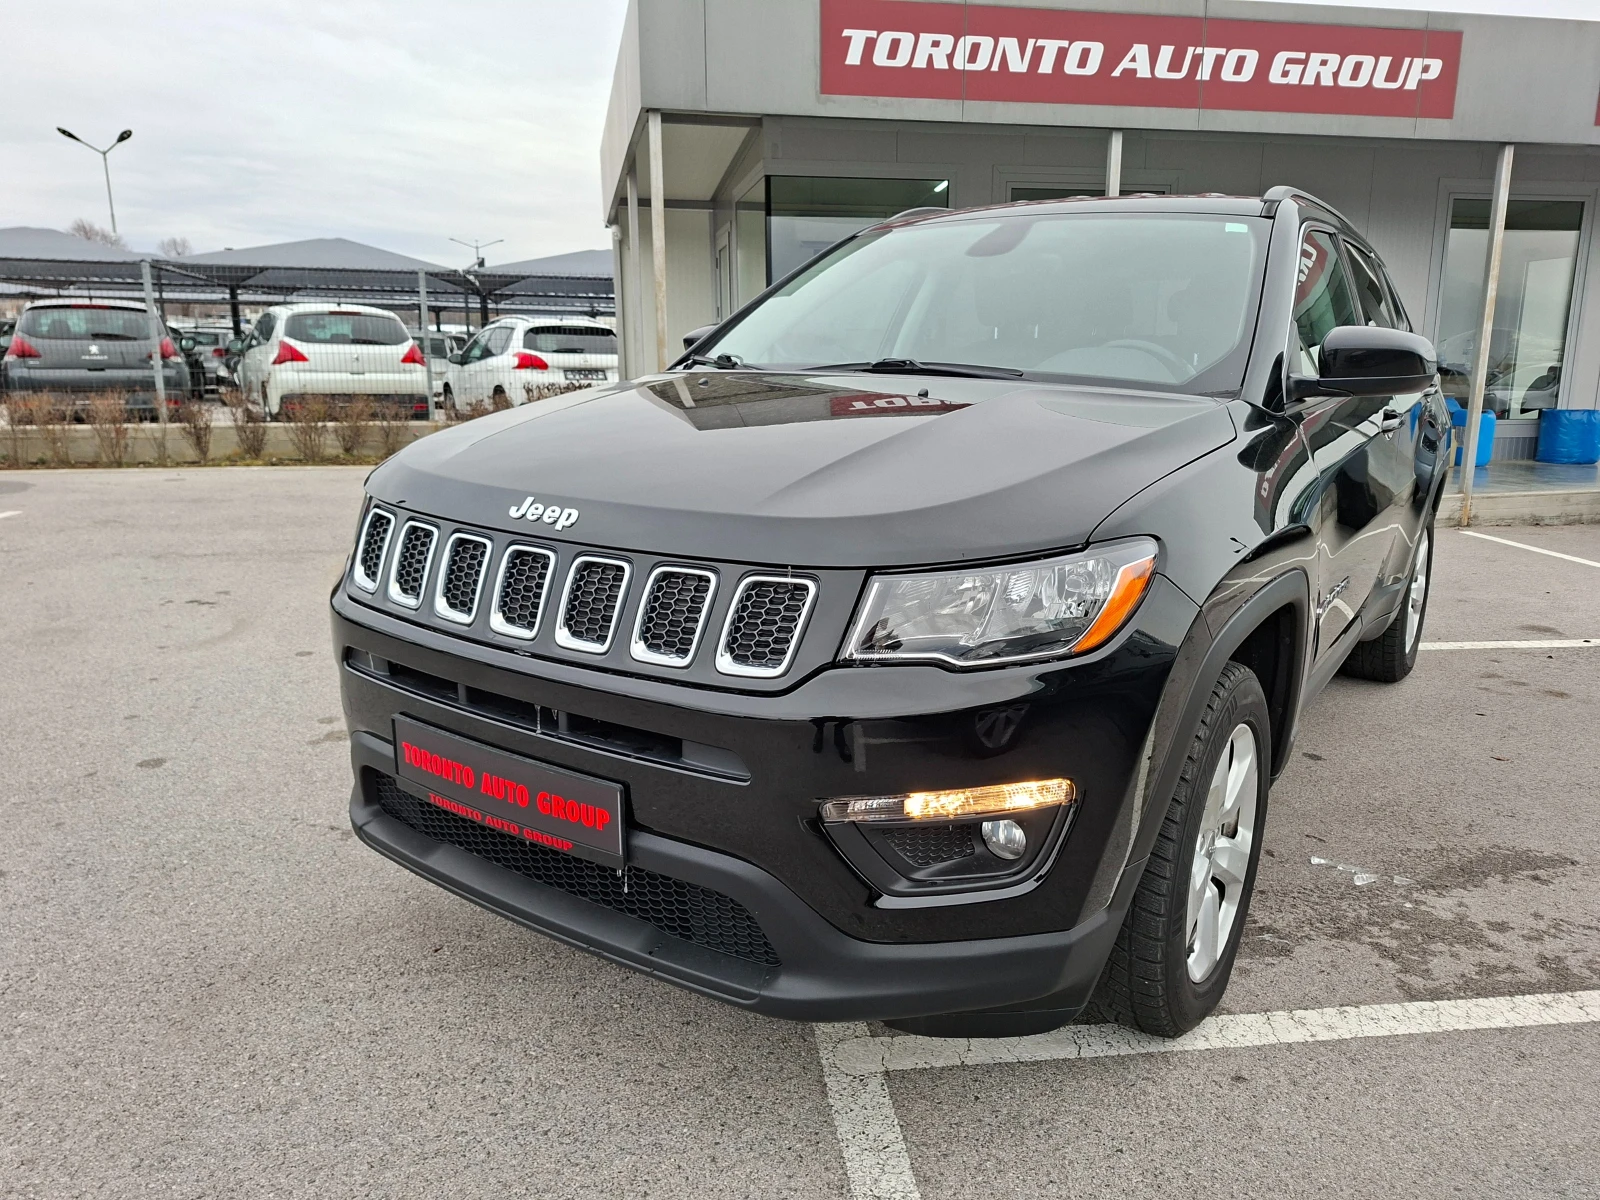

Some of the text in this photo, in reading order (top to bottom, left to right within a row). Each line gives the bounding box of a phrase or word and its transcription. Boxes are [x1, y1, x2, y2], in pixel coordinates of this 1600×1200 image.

[841, 28, 1443, 90] TORONTO AUTO GROUP
[509, 496, 579, 532] Jeep
[402, 741, 611, 831] TORONTO AUTO GROUP
[428, 792, 573, 851] TORONTO AUTO GROUP
